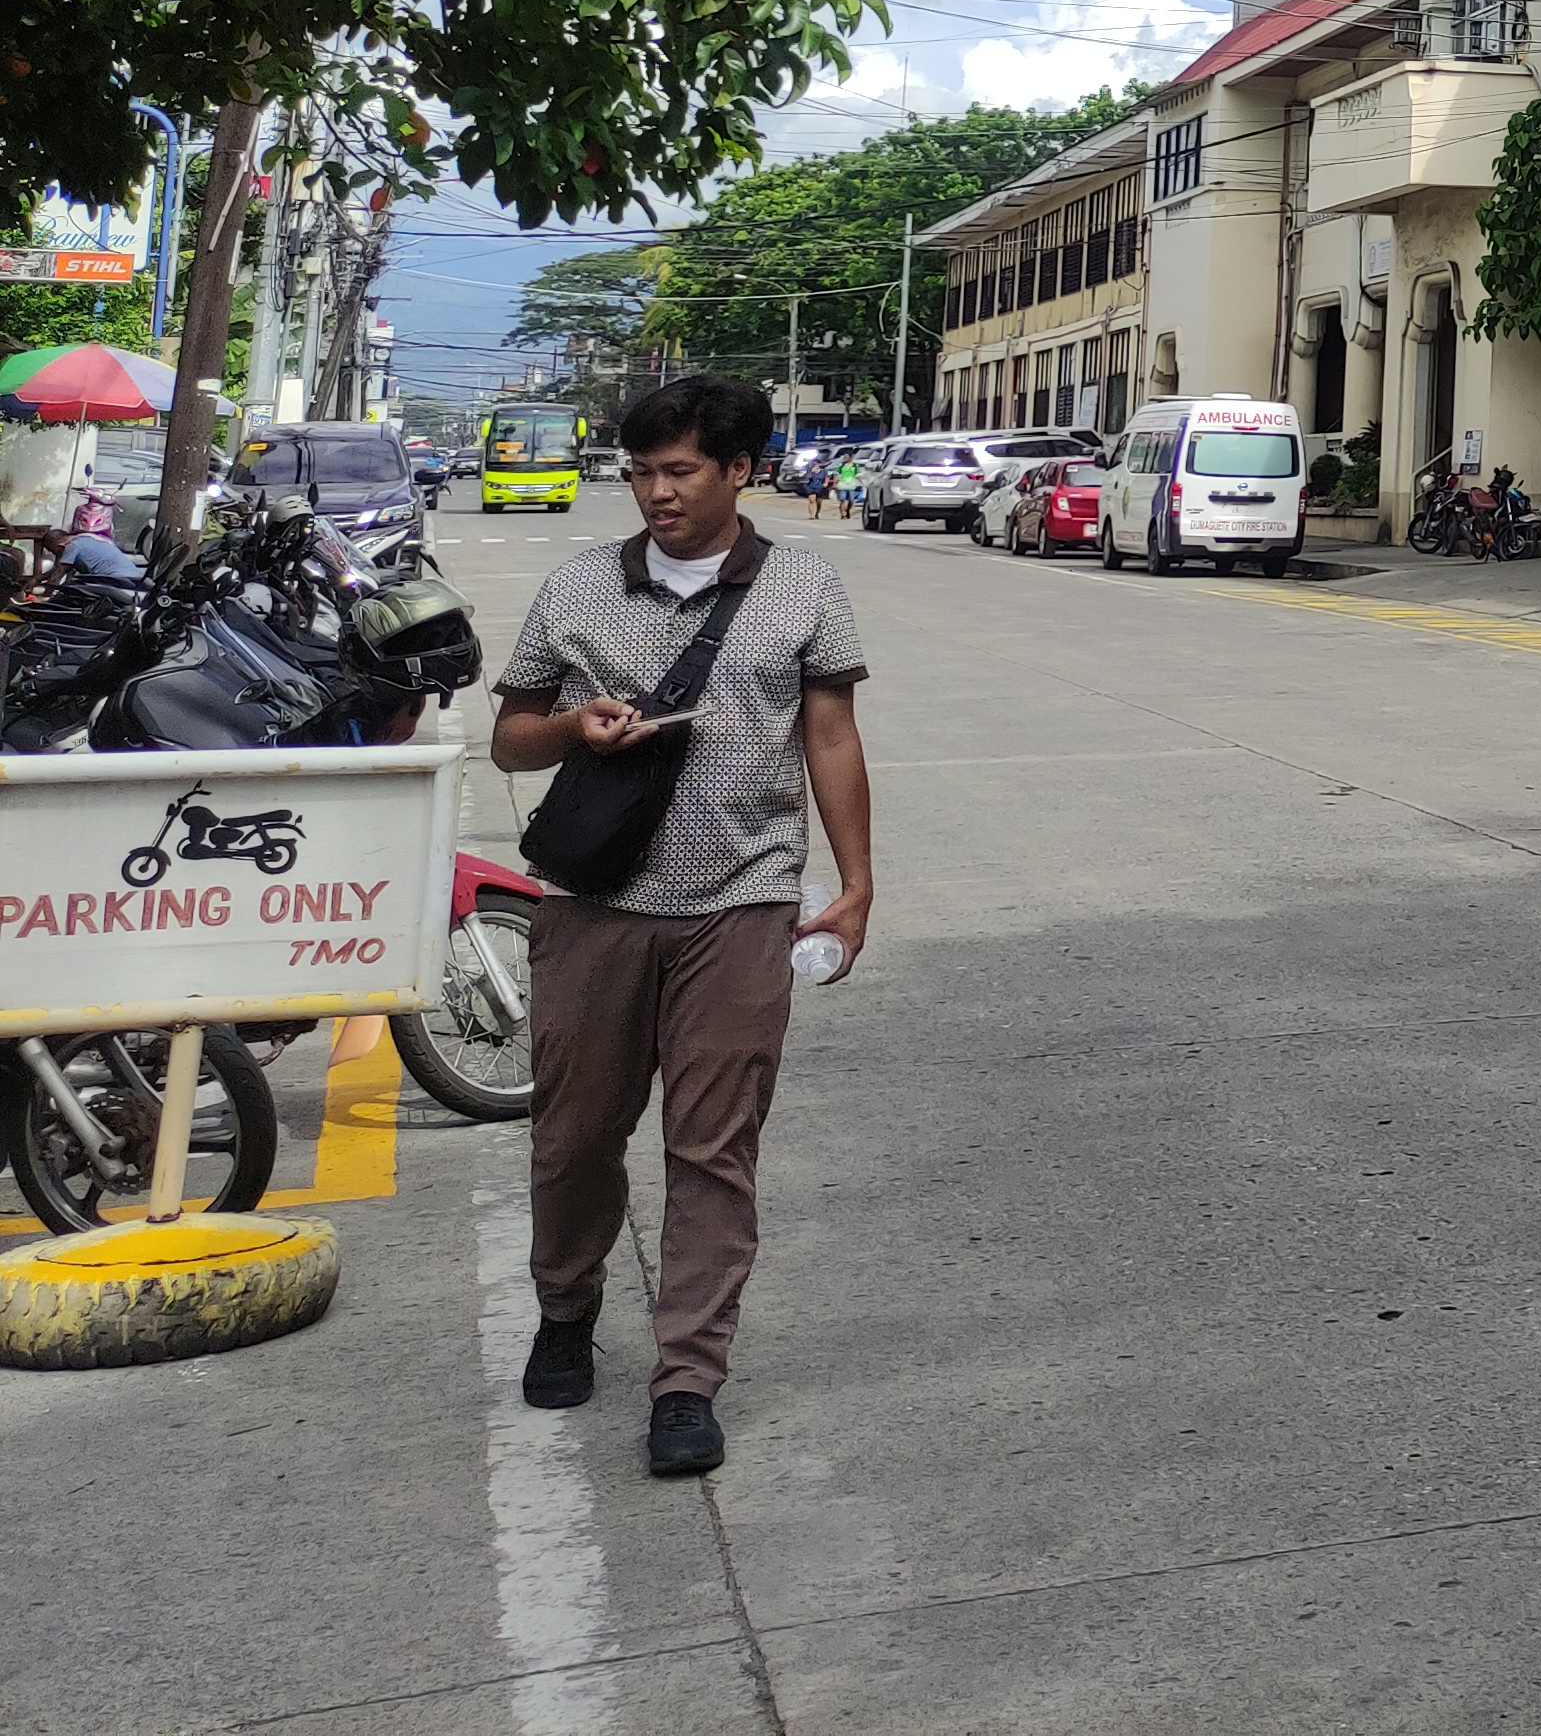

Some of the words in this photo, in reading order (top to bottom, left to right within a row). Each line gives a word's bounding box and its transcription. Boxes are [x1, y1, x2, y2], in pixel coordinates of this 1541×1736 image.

[65, 260, 126, 274] STIHL
[1197, 412, 1292, 426] AMBULANCE
[1190, 519, 1230, 532] DUMAGUETE
[1231, 520, 1246, 532] CITY
[1246, 521, 1262, 532] FIRE
[1262, 521, 1288, 532] STATION
[0, 886, 232, 939] PARKING
[260, 880, 391, 925] ONLY
[288, 937, 386, 966] TMO
